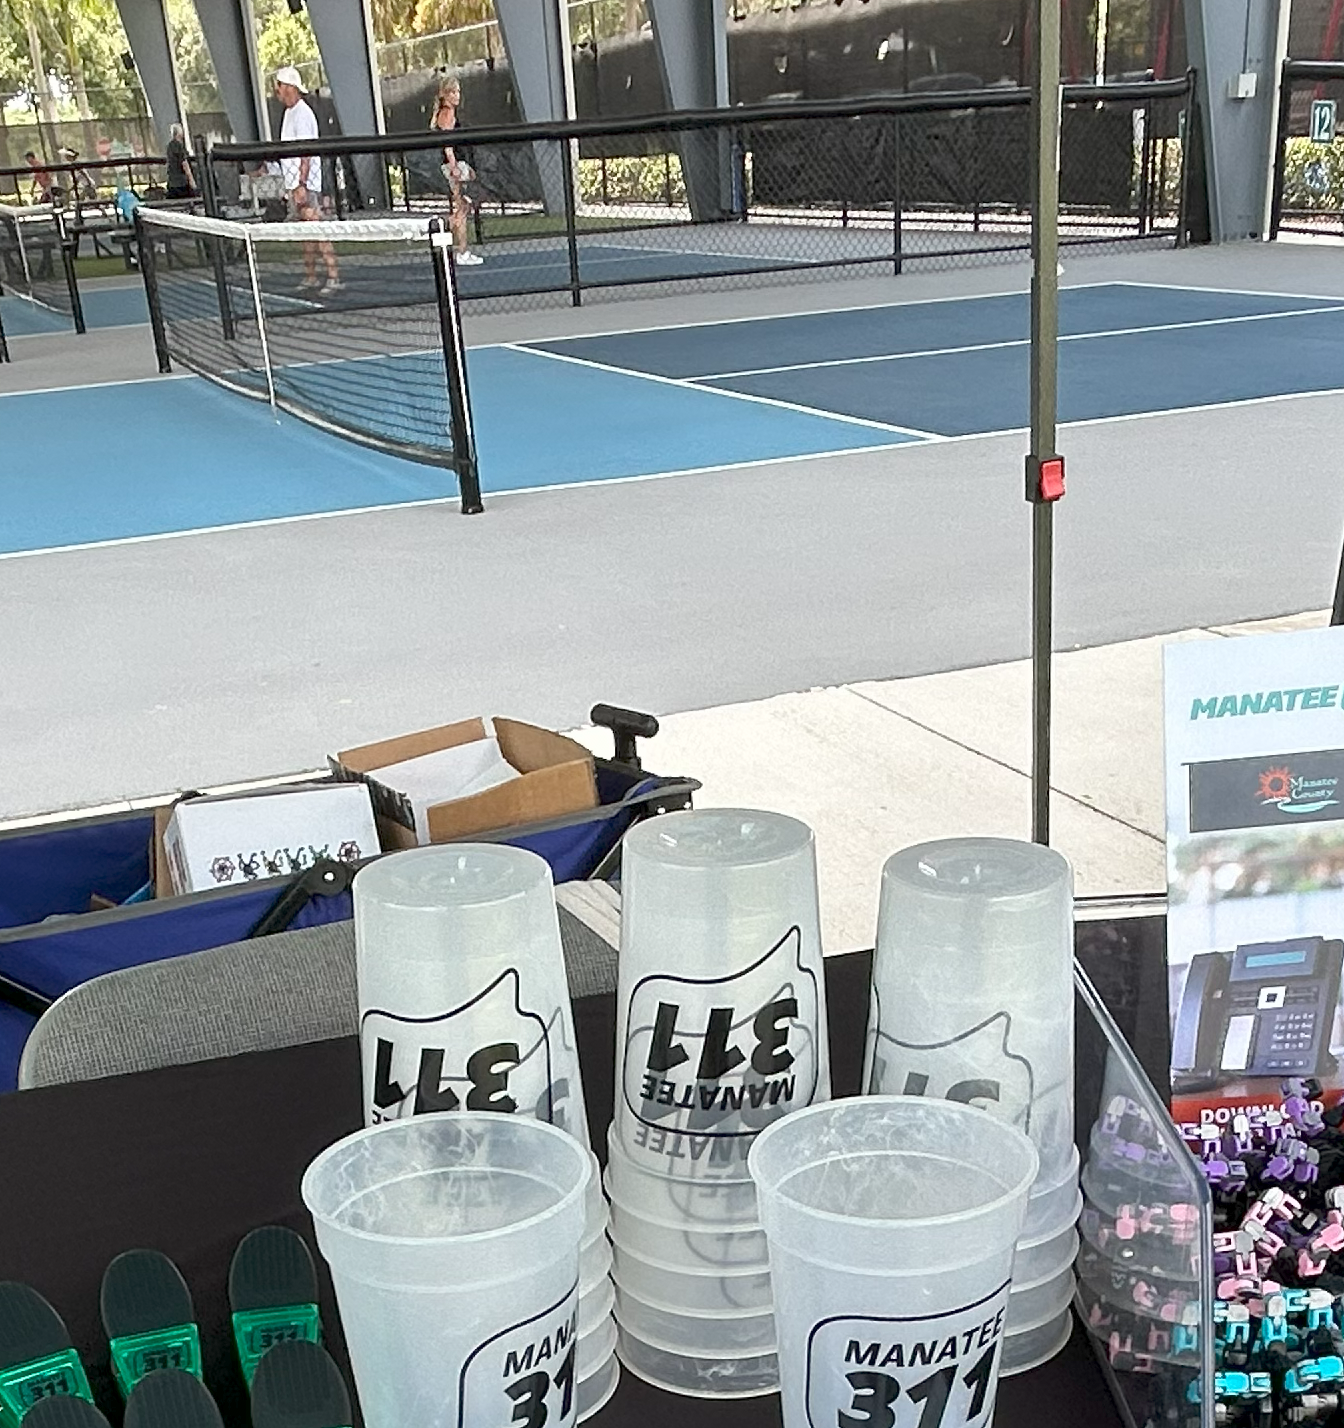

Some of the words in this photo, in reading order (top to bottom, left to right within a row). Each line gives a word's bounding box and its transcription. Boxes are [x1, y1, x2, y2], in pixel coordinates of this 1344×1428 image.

[1313, 106, 1330, 140] 12
[1191, 684, 1340, 720] MANATEE
[1292, 789, 1335, 801] County
[646, 998, 800, 1080] 311
[373, 1037, 520, 1114] 311
[640, 1074, 795, 1112] MANATEE
[633, 1124, 762, 1170] ANATEE
[503, 1310, 577, 1377] MANA
[844, 1307, 1005, 1367] MANATEE
